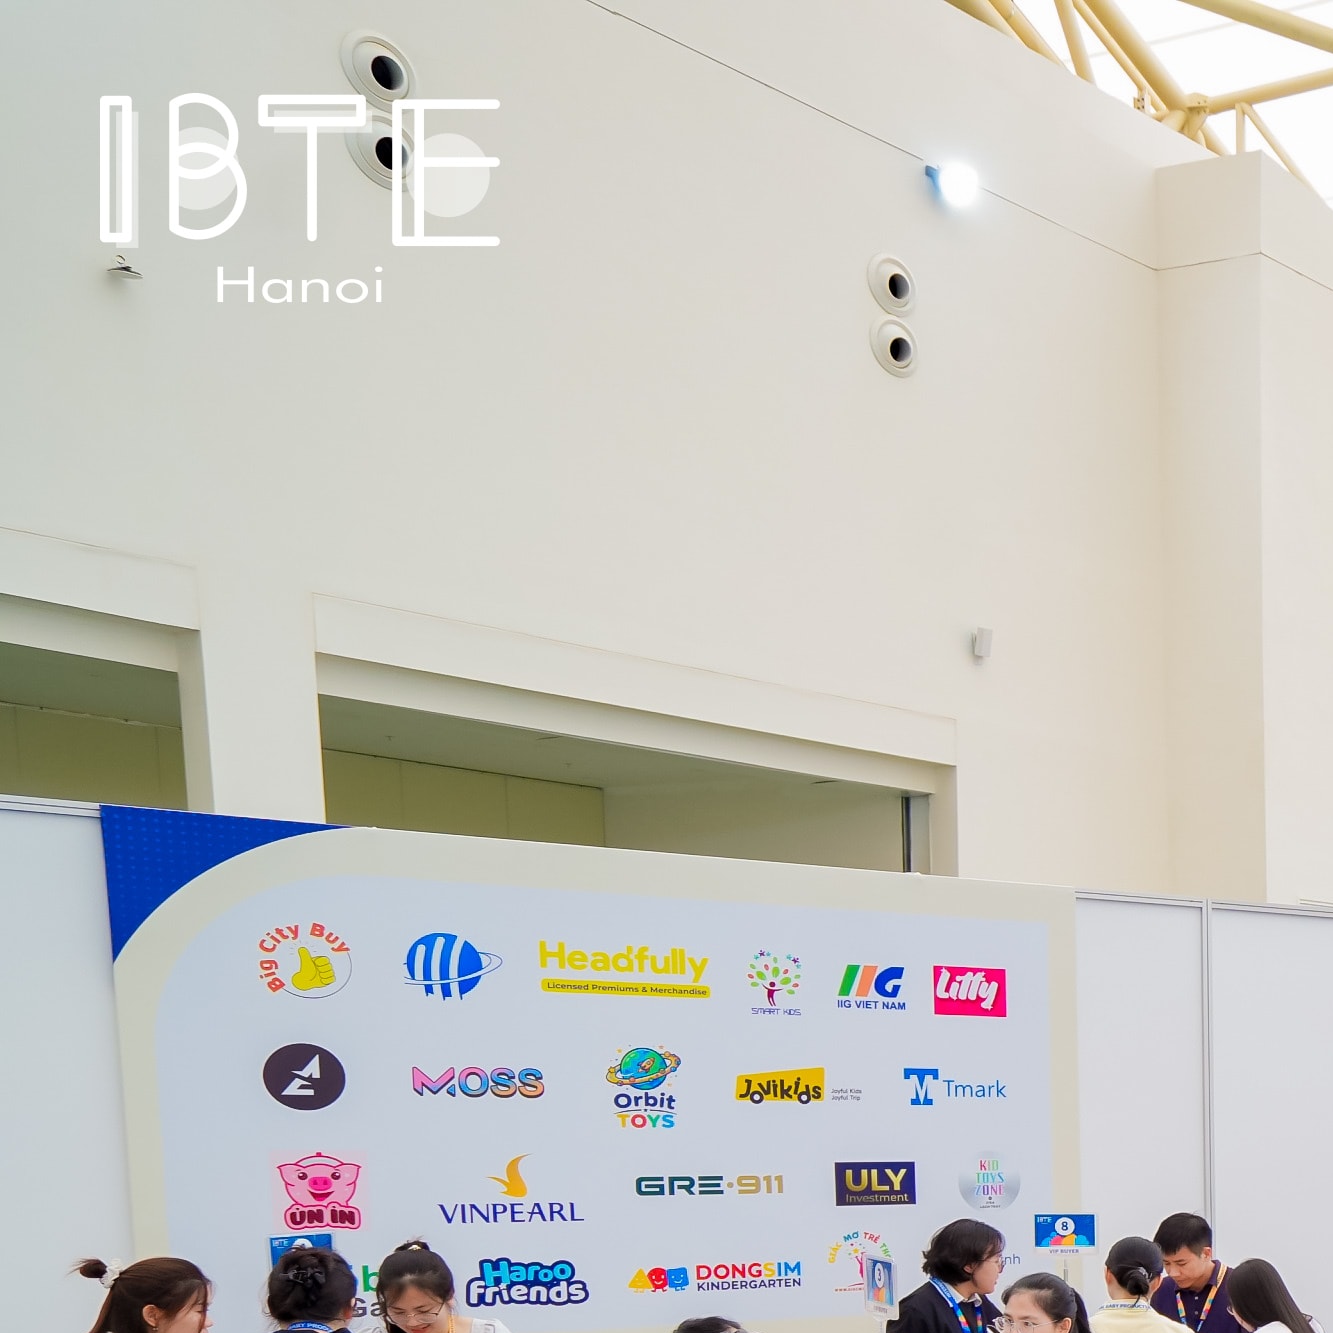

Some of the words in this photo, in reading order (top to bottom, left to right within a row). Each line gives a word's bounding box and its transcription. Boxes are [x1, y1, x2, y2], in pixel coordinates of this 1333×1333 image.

[258, 923, 300, 955] City
[309, 921, 351, 955] Buy
[538, 940, 709, 983] Headfully
[259, 958, 286, 993] Big
[546, 980, 590, 992] Licensed
[591, 983, 639, 994] Premiums
[640, 986, 648, 994] &
[650, 986, 708, 996] Merchandise
[837, 1000, 852, 1009] IIG
[854, 1000, 879, 1010] VIET
[881, 1001, 906, 1011] NAM
[411, 1066, 546, 1099] MOSS
[942, 1079, 1007, 1099] Tmark
[614, 1092, 676, 1110] Orbit
[616, 1114, 676, 1129] TOYS
[980, 1160, 998, 1171] KID
[845, 1168, 908, 1192] ULY
[976, 1172, 1005, 1184] TOYS
[846, 1192, 909, 1204] Investment
[974, 1184, 1005, 1196] ZONE
[438, 1202, 585, 1225] VINPEARL
[1060, 1221, 1069, 1231] 8
[483, 1259, 574, 1287] Haroo
[696, 1261, 802, 1281] DONGSIM
[876, 1266, 882, 1282] 3
[696, 1277, 802, 1292] KINDERGARTEN
